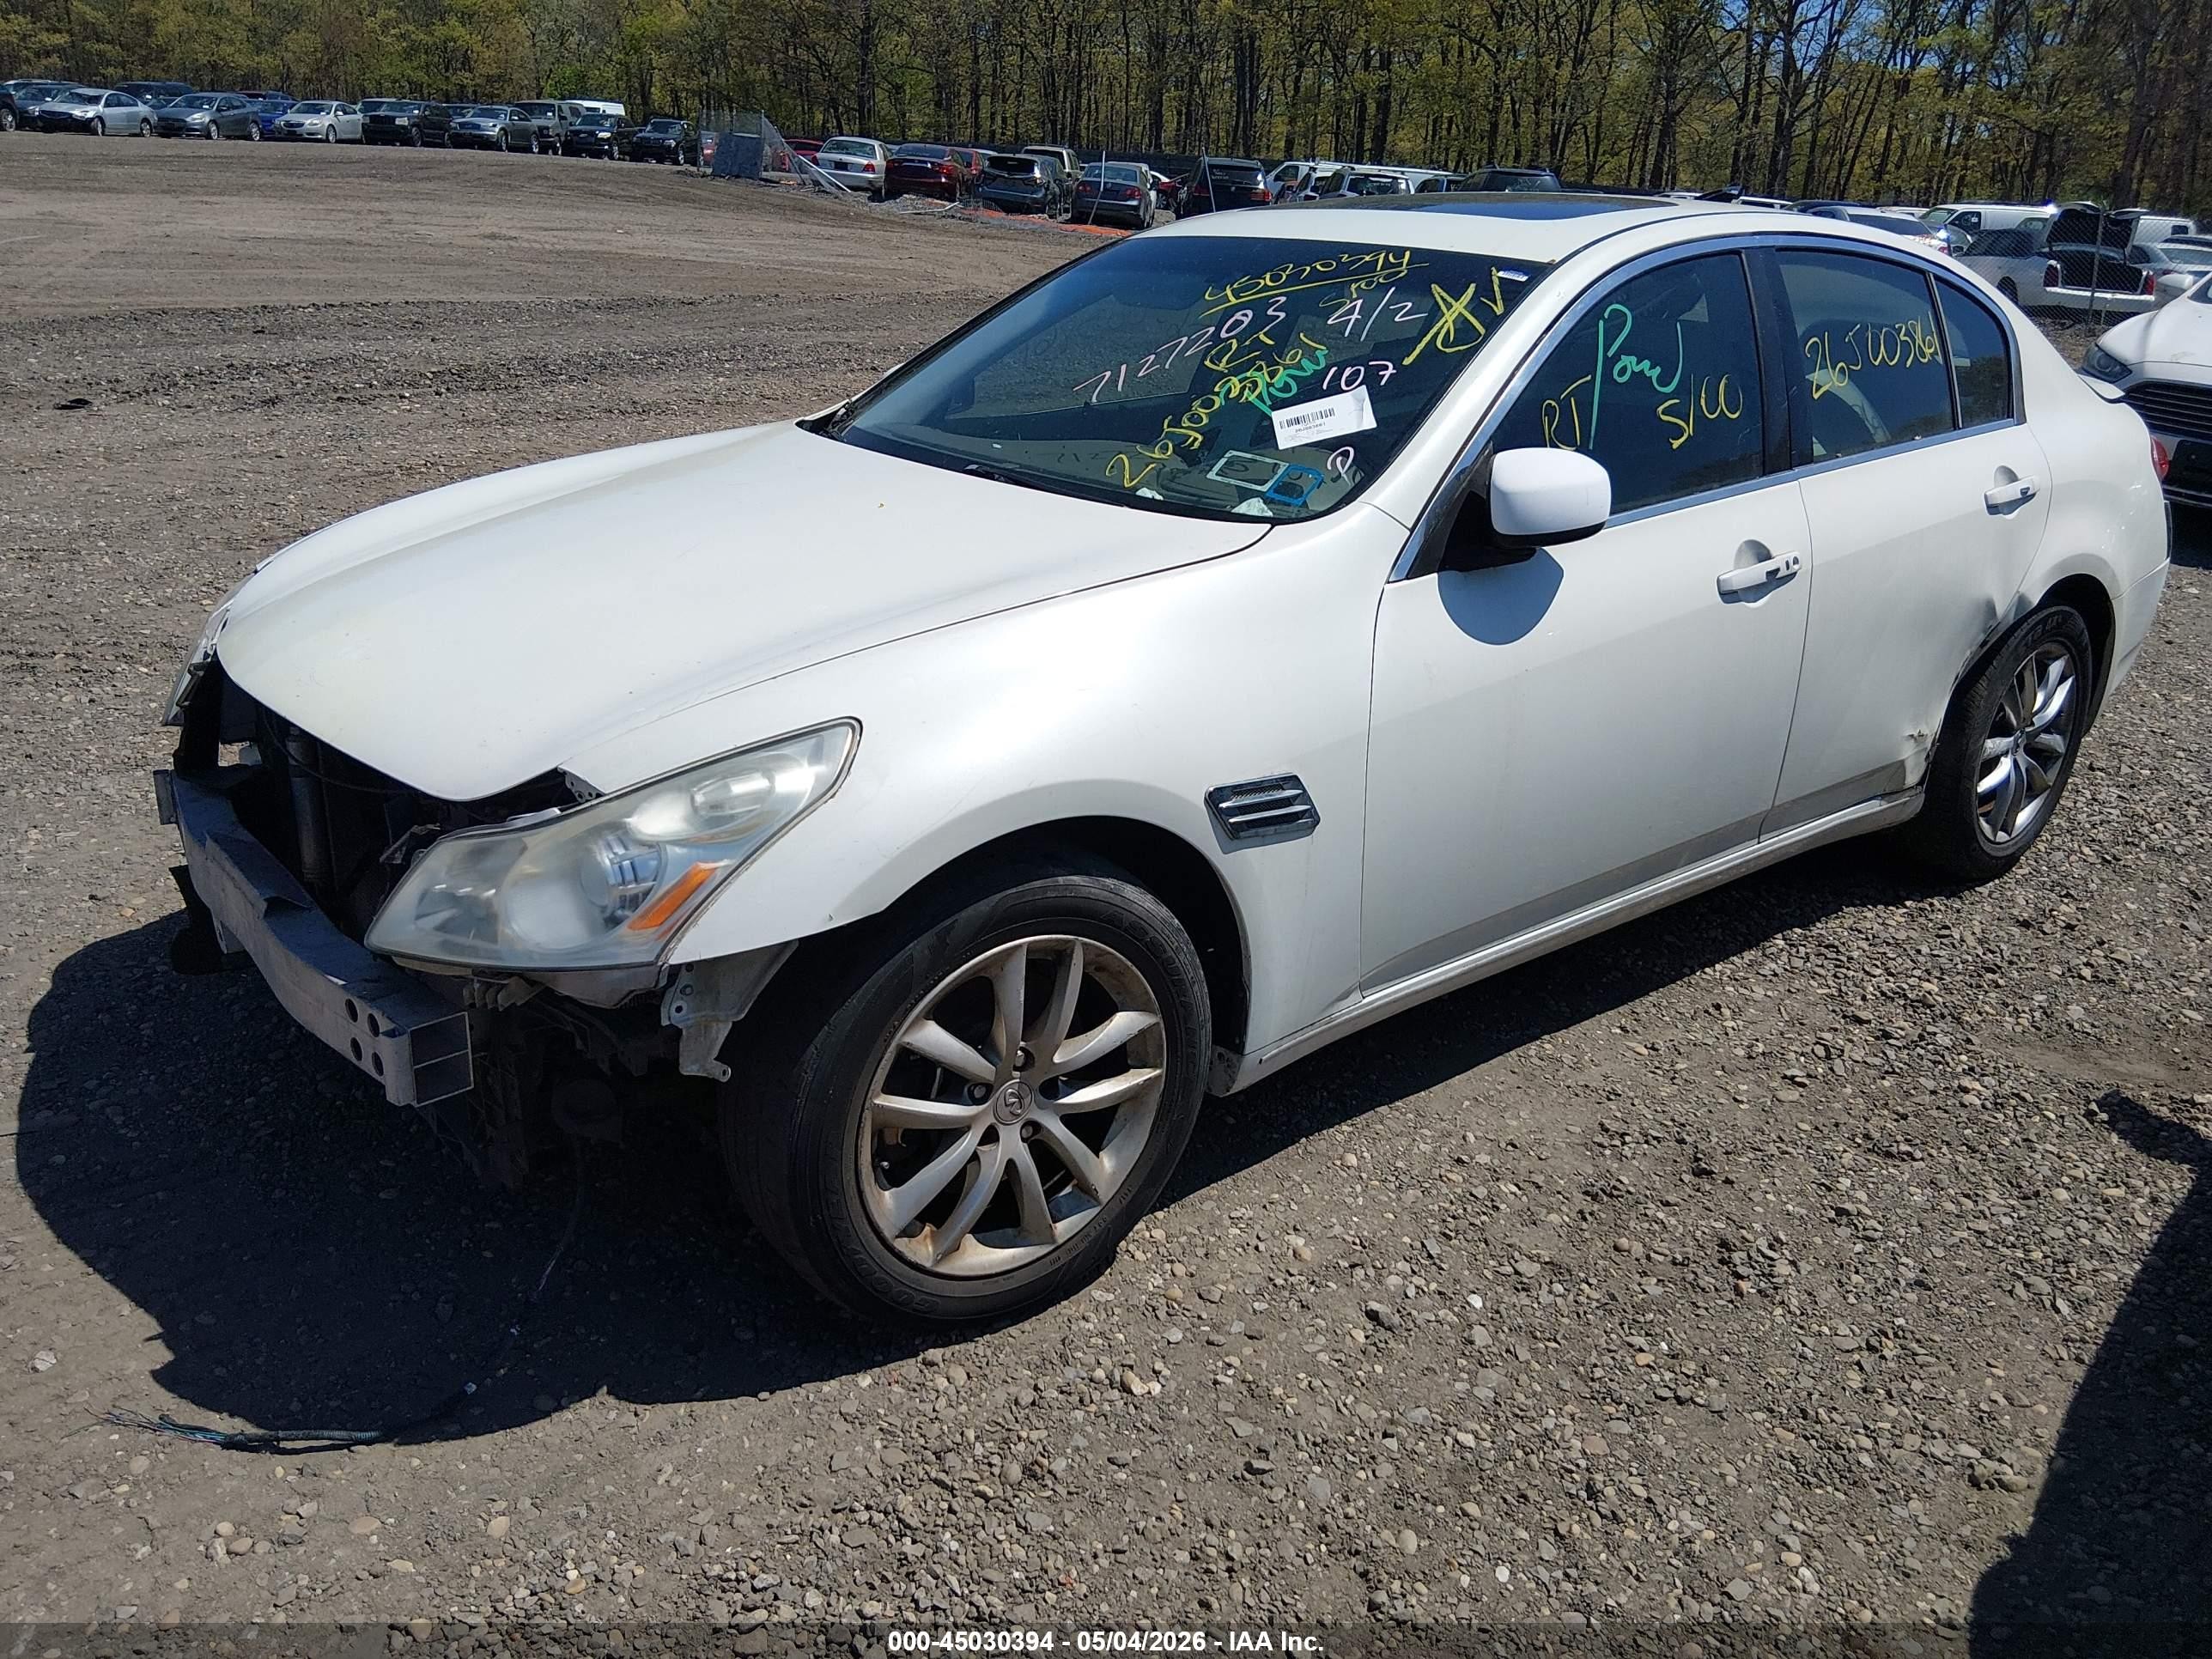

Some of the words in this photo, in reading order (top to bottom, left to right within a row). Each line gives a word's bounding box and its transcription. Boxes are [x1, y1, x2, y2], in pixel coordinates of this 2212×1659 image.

[1205, 250, 1411, 303] 45030394
[1327, 286, 1428, 341] 4/2
[1322, 361, 1396, 392] 107
[1542, 374, 1591, 450] RT
